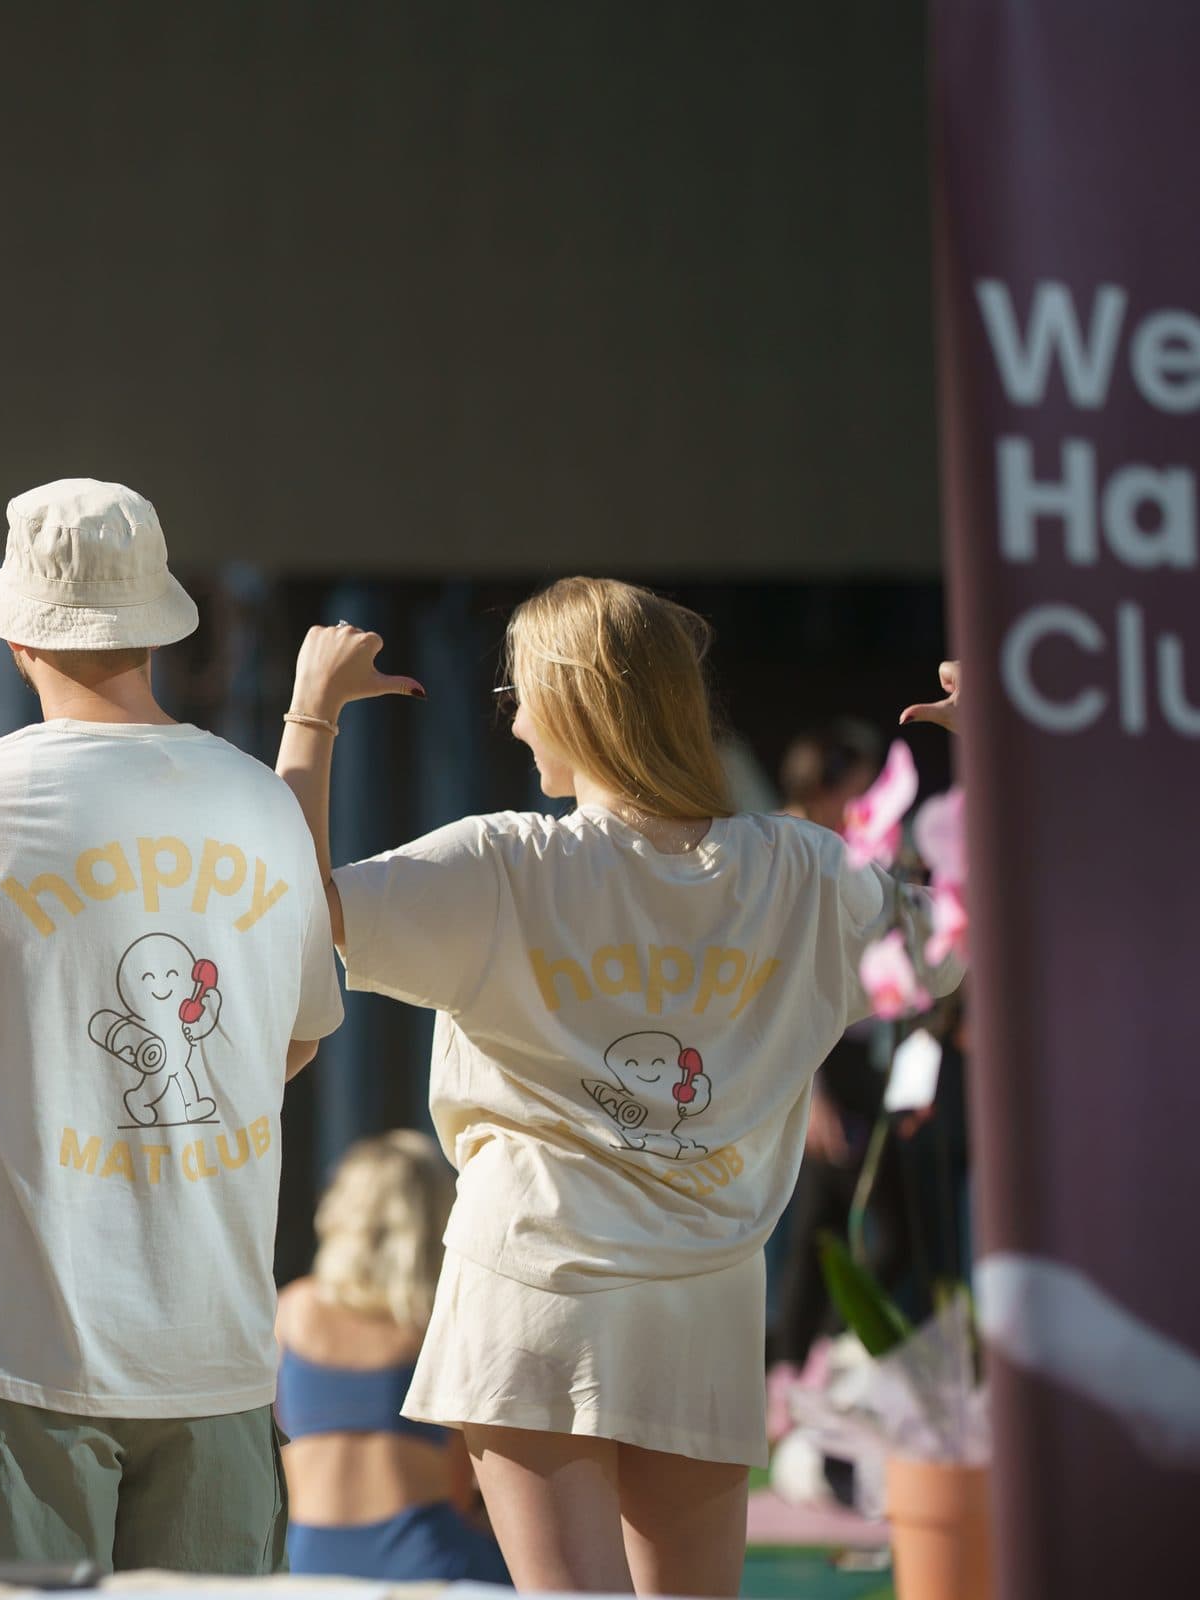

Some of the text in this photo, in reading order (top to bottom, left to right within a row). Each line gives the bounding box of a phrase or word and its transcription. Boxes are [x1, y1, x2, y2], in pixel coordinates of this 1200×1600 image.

[0, 835, 289, 939] happy
[530, 943, 783, 1019] happy
[59, 1115, 272, 1185] MAT CLUB
